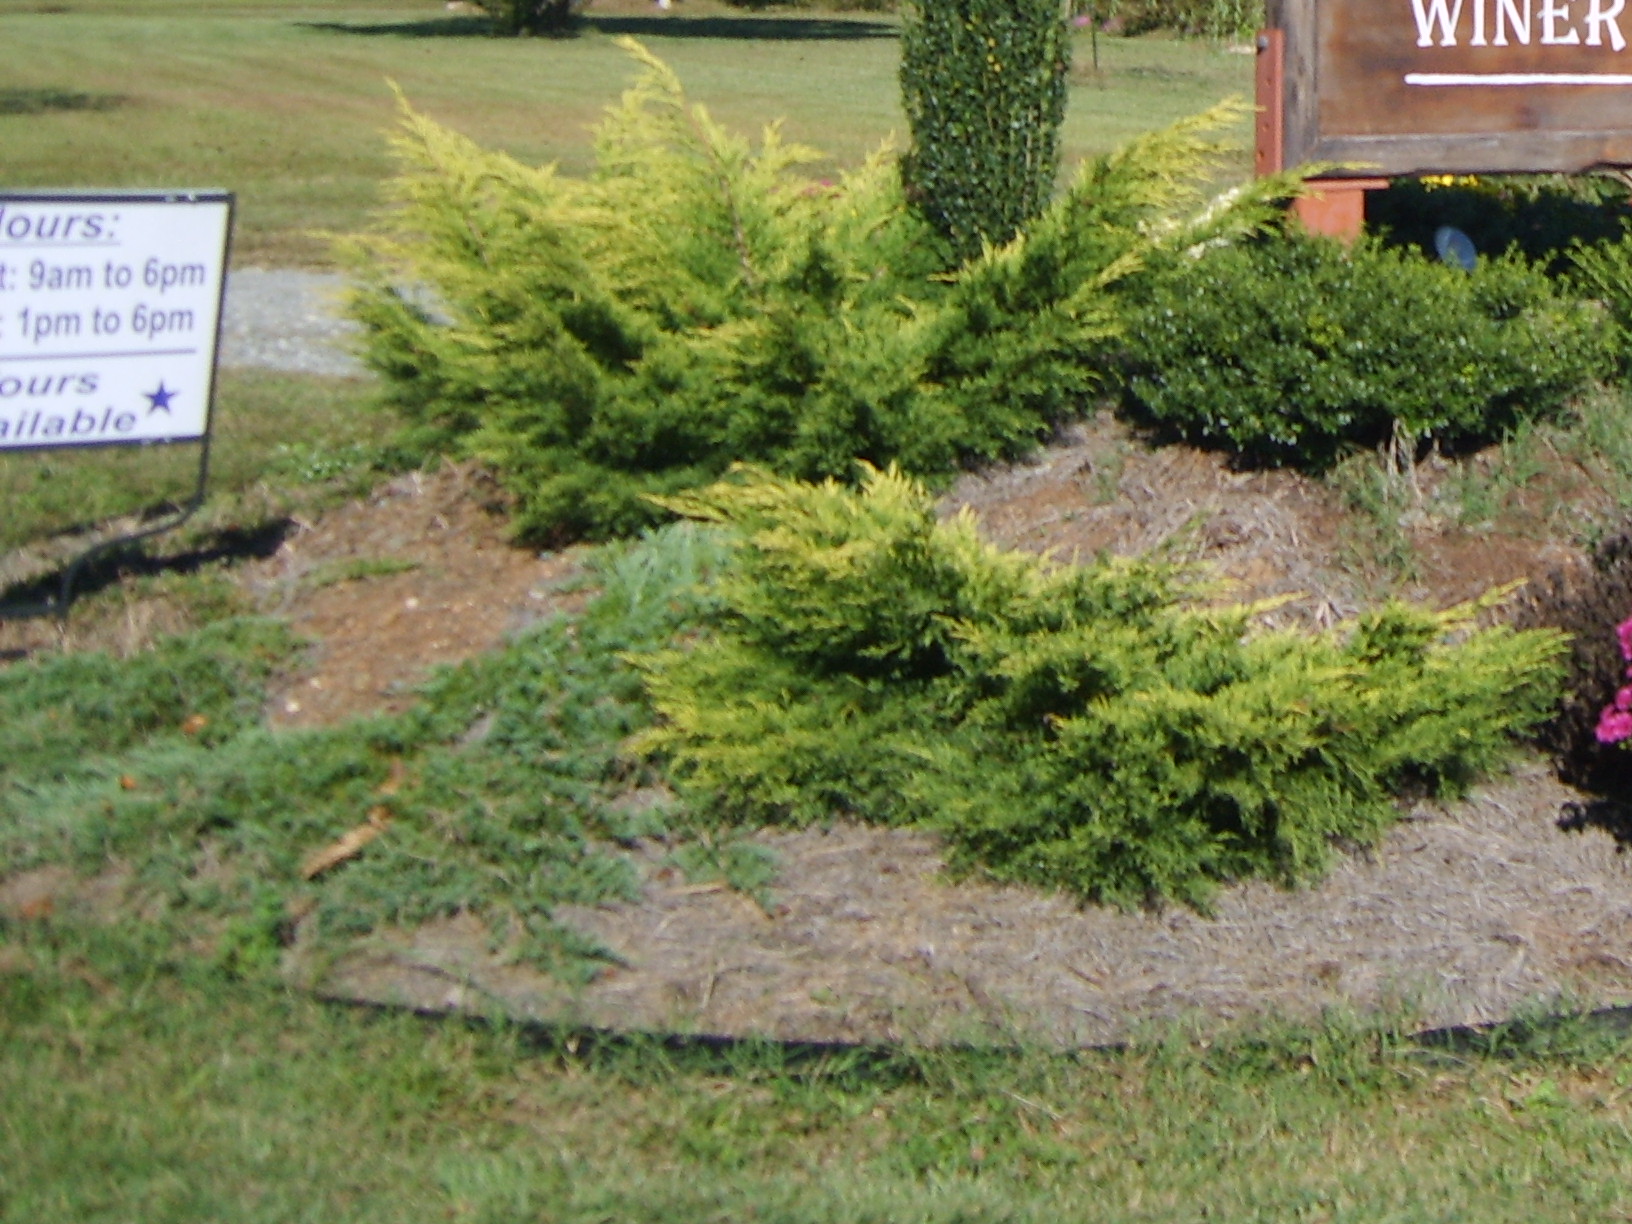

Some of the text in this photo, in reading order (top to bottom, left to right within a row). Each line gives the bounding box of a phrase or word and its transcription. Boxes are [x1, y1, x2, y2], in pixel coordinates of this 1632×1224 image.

[0, 206, 121, 239] ours:
[29, 259, 92, 290] 9am
[104, 261, 132, 288] to
[143, 257, 205, 295] 6pm
[20, 306, 81, 345] 1pm
[93, 308, 121, 335] to
[132, 304, 194, 339] 6pm
